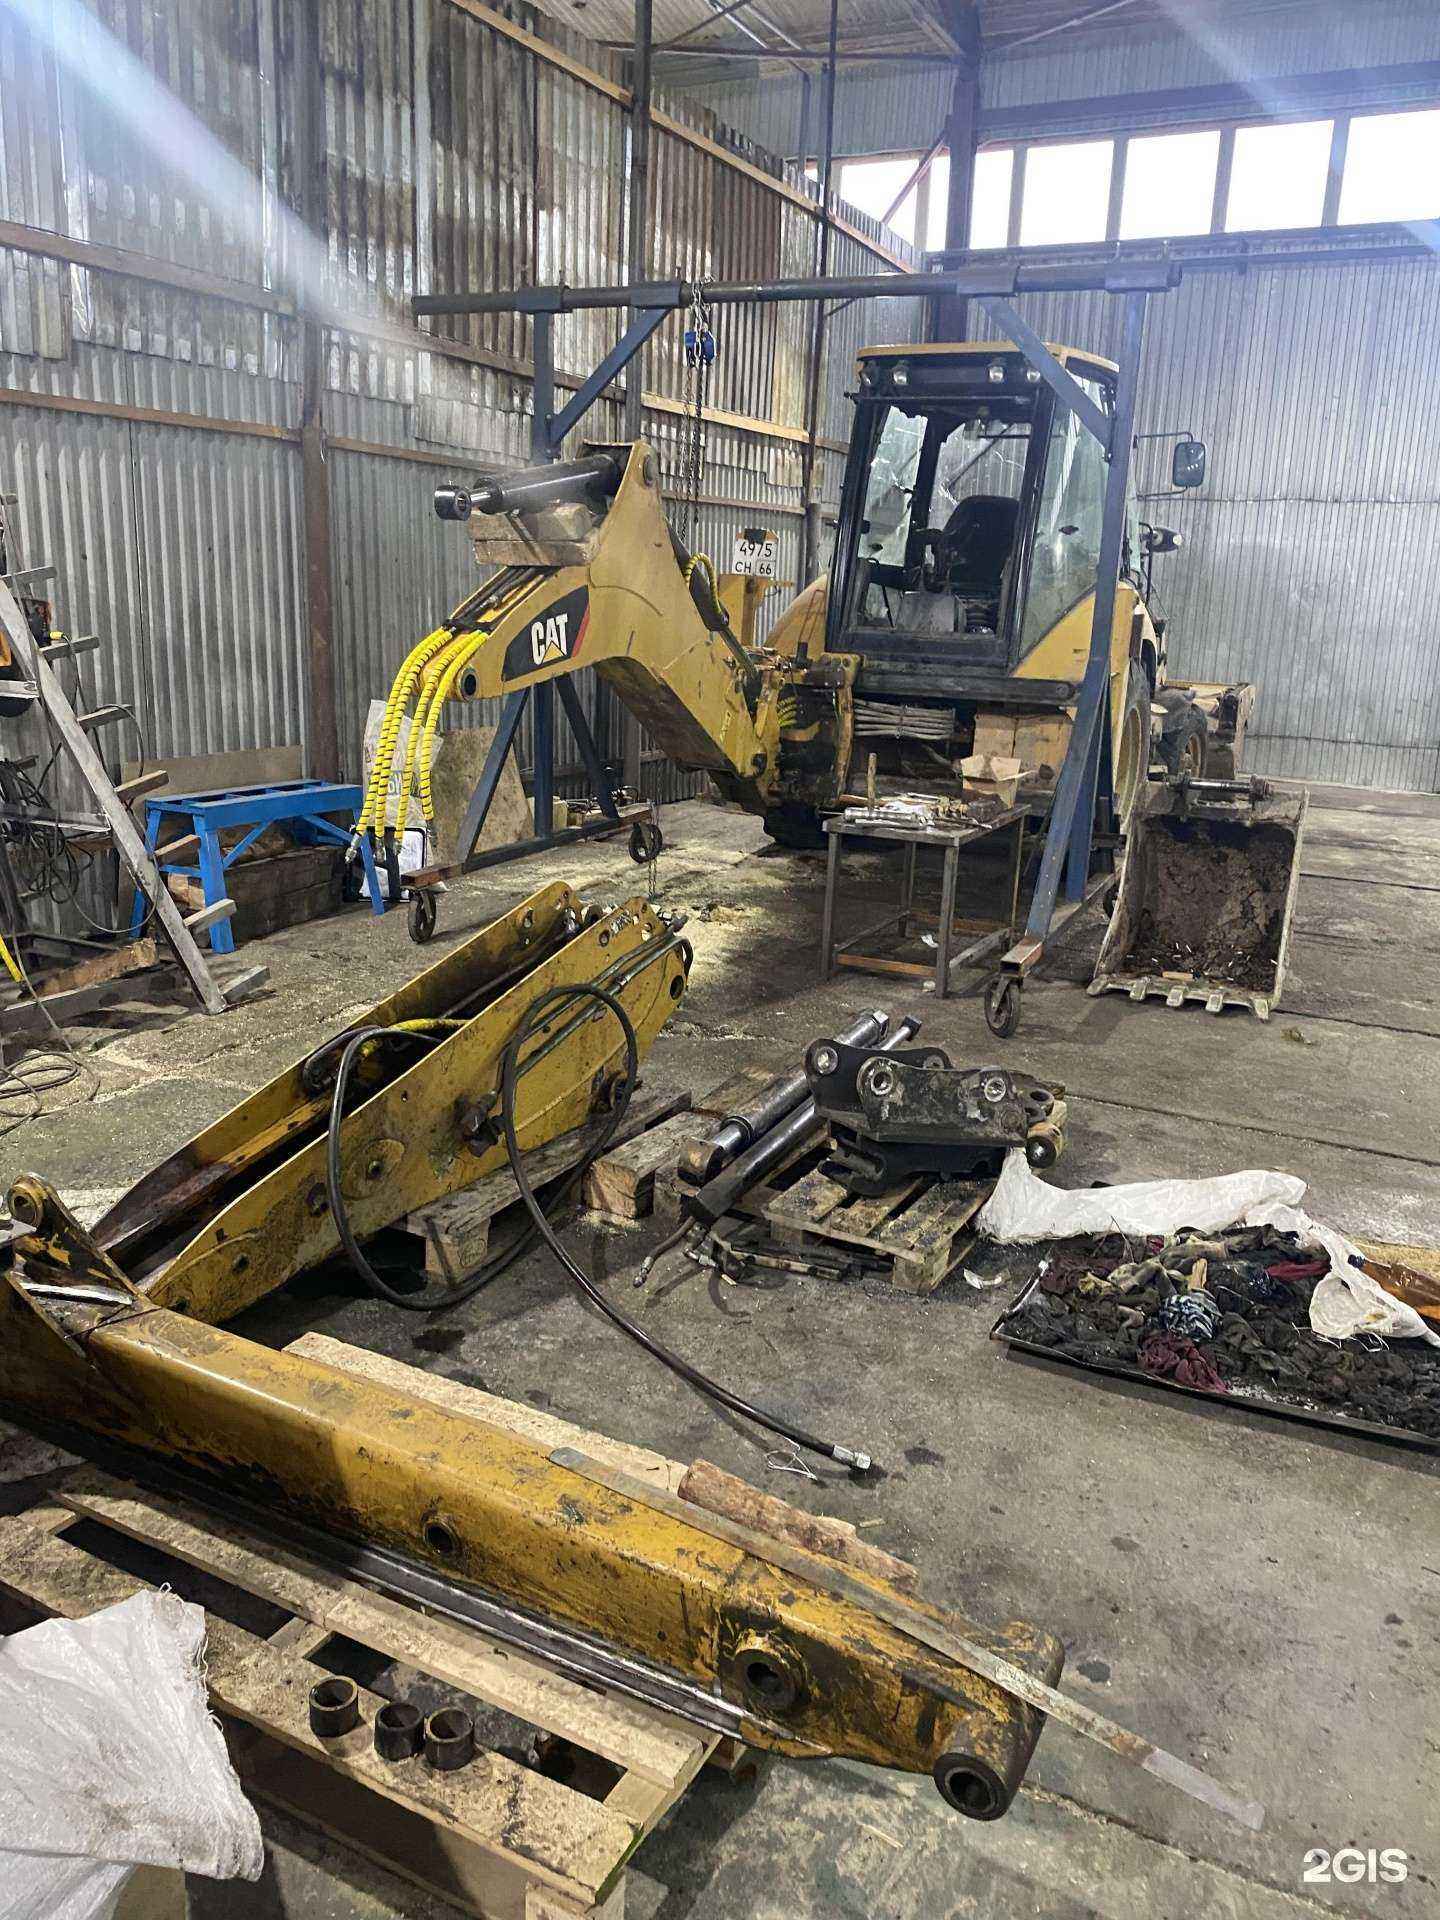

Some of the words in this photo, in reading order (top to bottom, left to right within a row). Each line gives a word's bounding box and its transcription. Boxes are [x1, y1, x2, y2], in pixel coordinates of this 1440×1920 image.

[740, 541, 773, 558] 4975
[759, 563, 772, 575] 66
[531, 613, 568, 665] CAT
